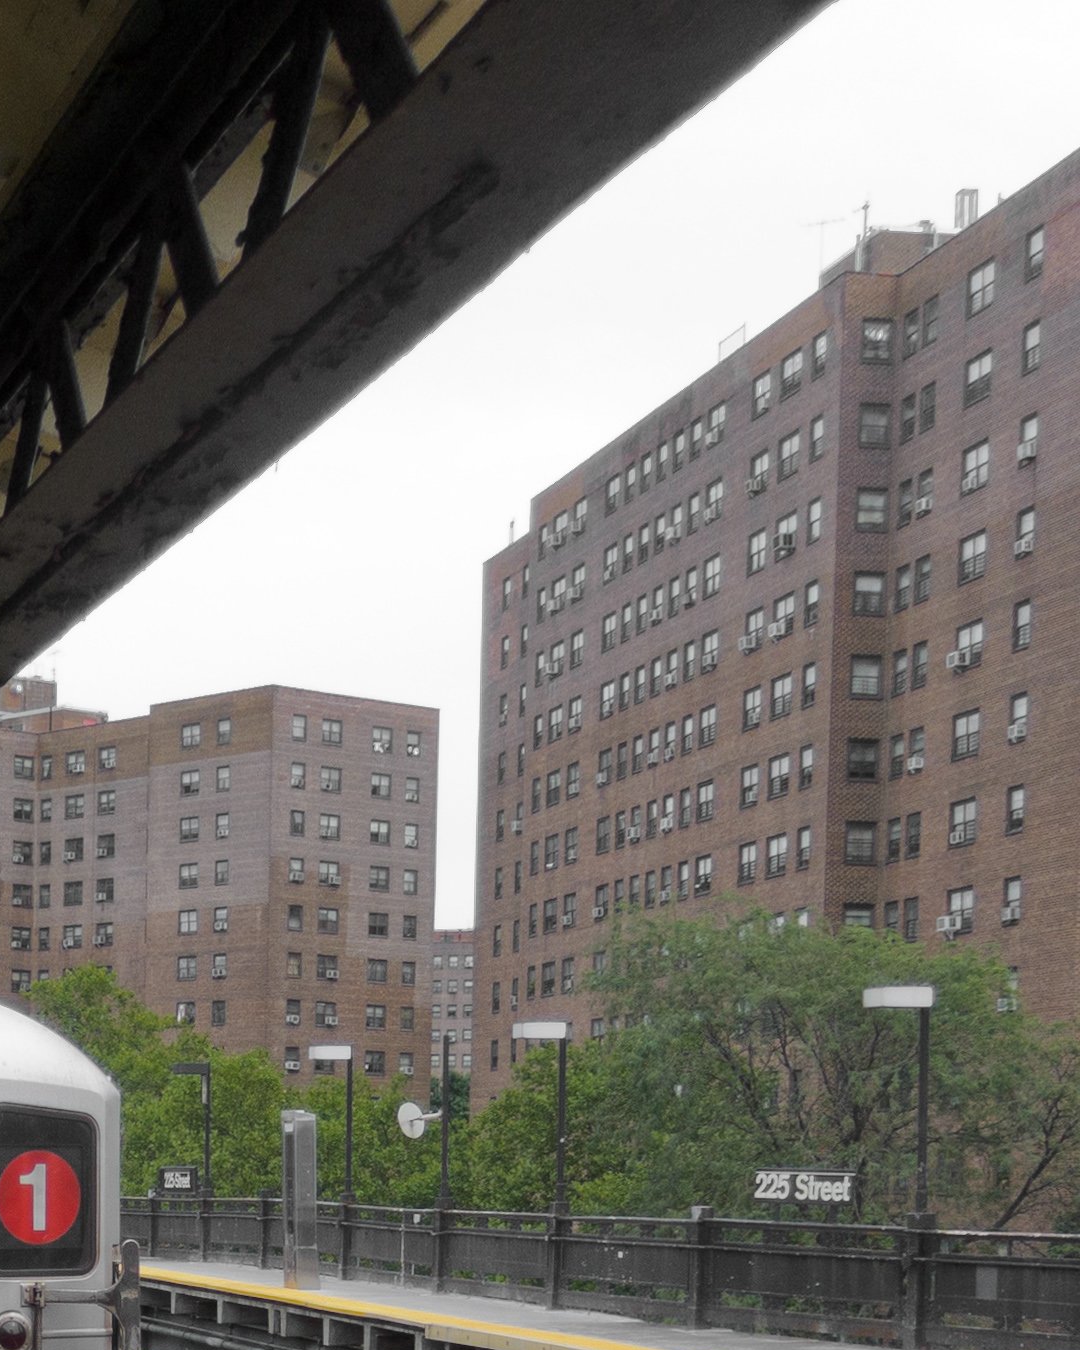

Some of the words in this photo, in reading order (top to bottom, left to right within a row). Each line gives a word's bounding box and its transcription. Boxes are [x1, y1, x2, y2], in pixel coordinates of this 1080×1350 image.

[19, 1163, 46, 1231] 1
[754, 1173, 791, 1200] 225
[794, 1174, 851, 1202] Street
